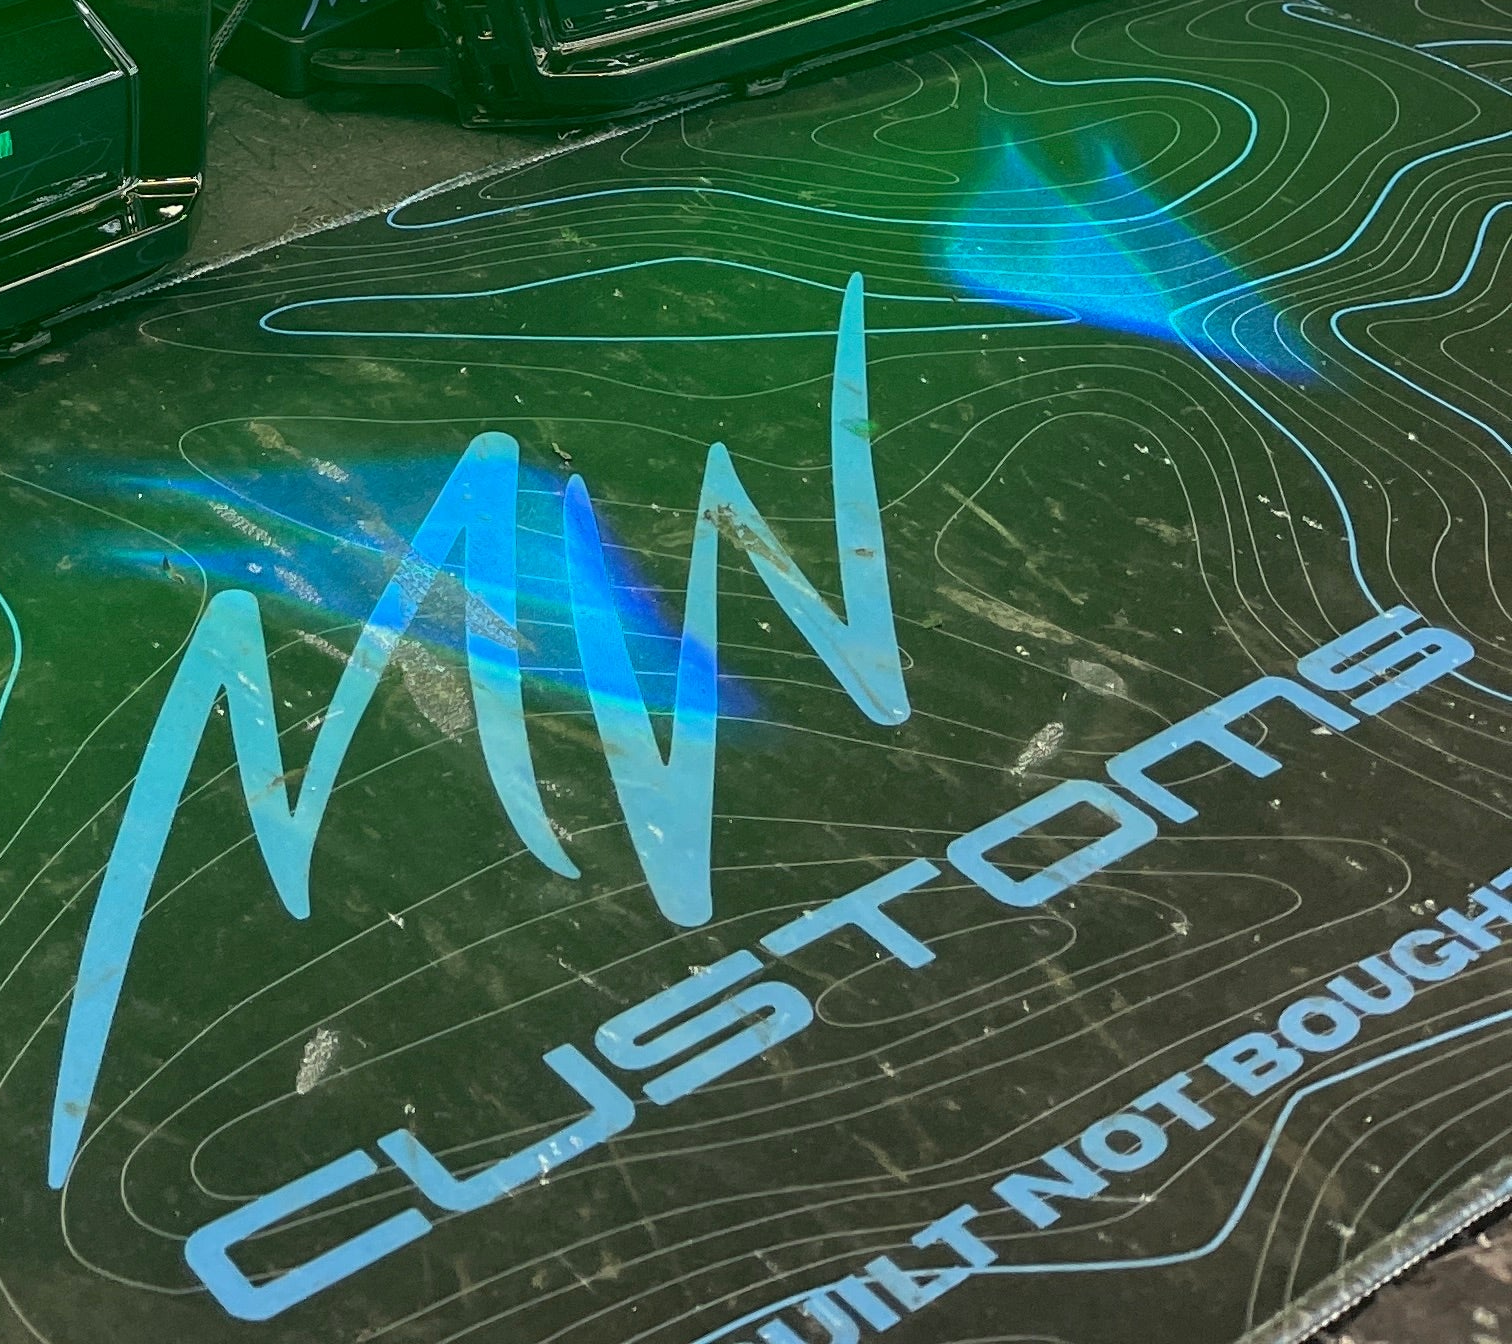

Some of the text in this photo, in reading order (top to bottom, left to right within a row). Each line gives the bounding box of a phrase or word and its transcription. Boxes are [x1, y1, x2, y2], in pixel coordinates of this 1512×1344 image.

[48, 272, 912, 1190] MW
[182, 603, 1476, 1322] CUSTOMS
[733, 1203, 999, 1344] UILT
[992, 1072, 1215, 1230] NOT
